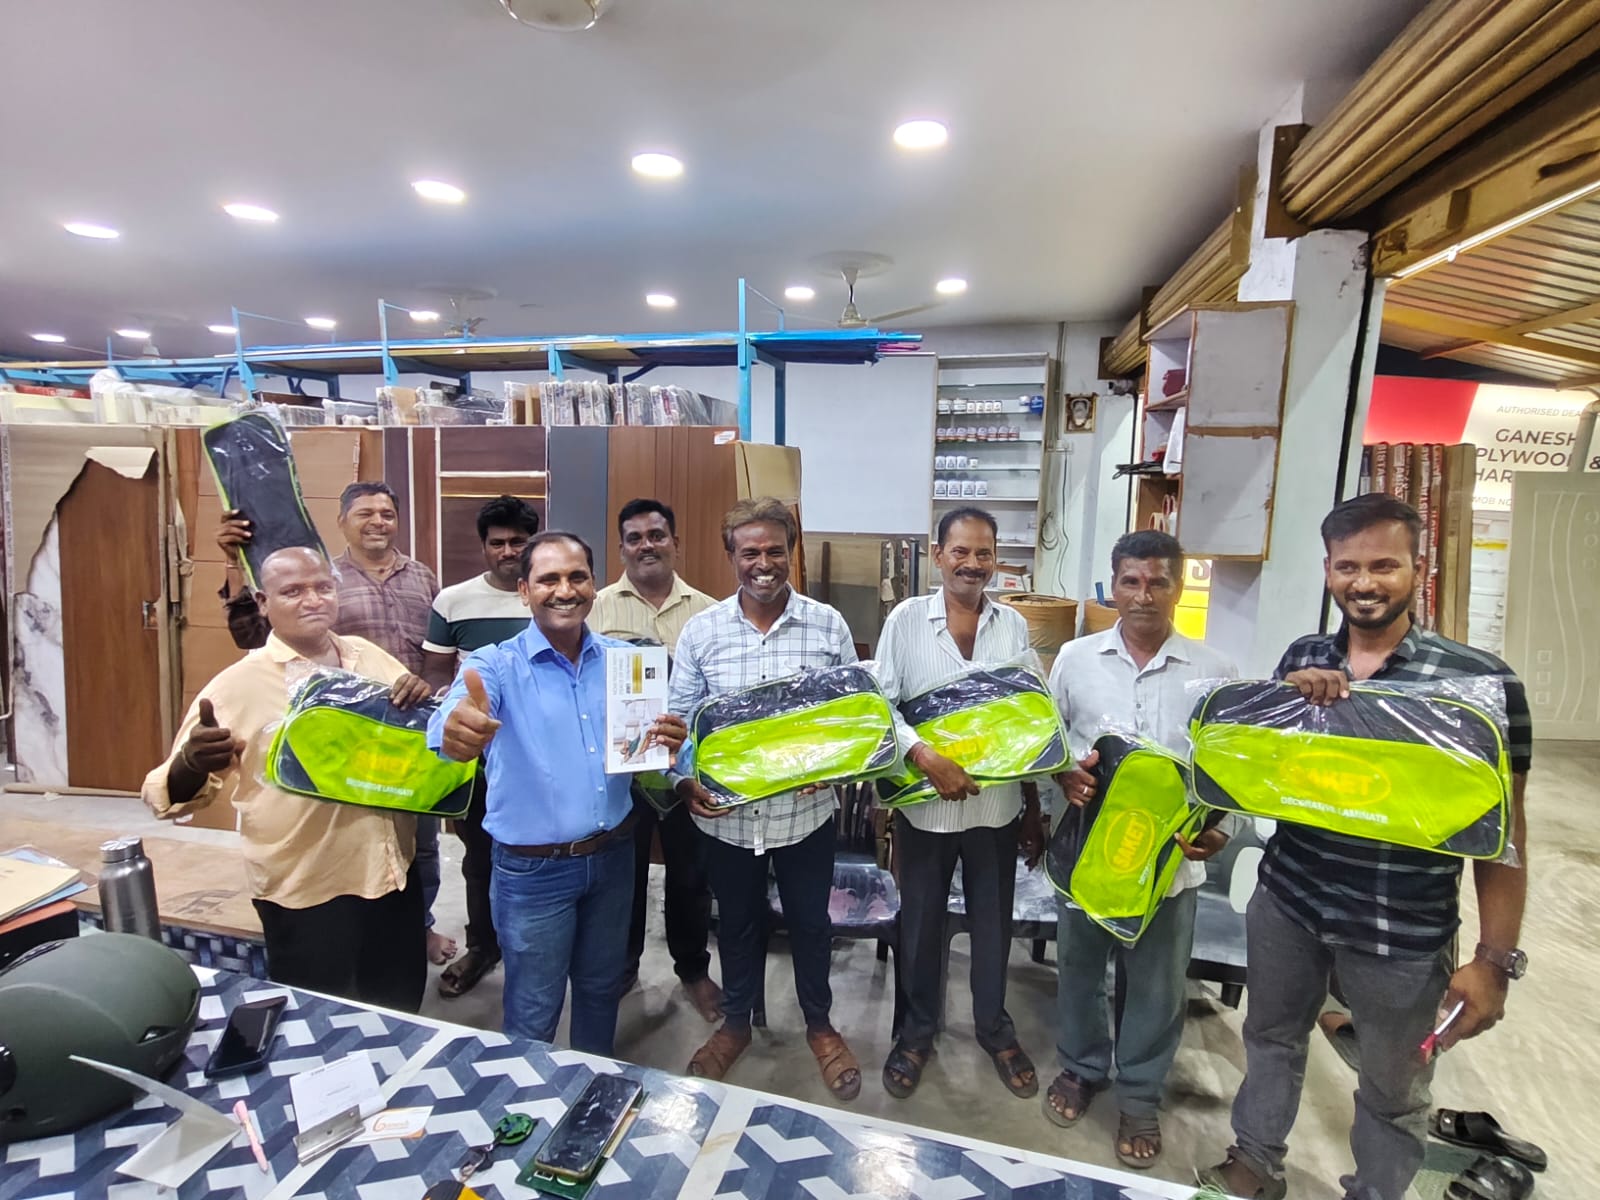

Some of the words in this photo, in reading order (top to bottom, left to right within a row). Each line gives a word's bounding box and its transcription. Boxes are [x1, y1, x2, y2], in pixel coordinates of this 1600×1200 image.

[1496, 405, 1560, 417] AUTHORISED
[1562, 409, 1581, 417] DEA
[1475, 447, 1572, 467] PLYWOO
